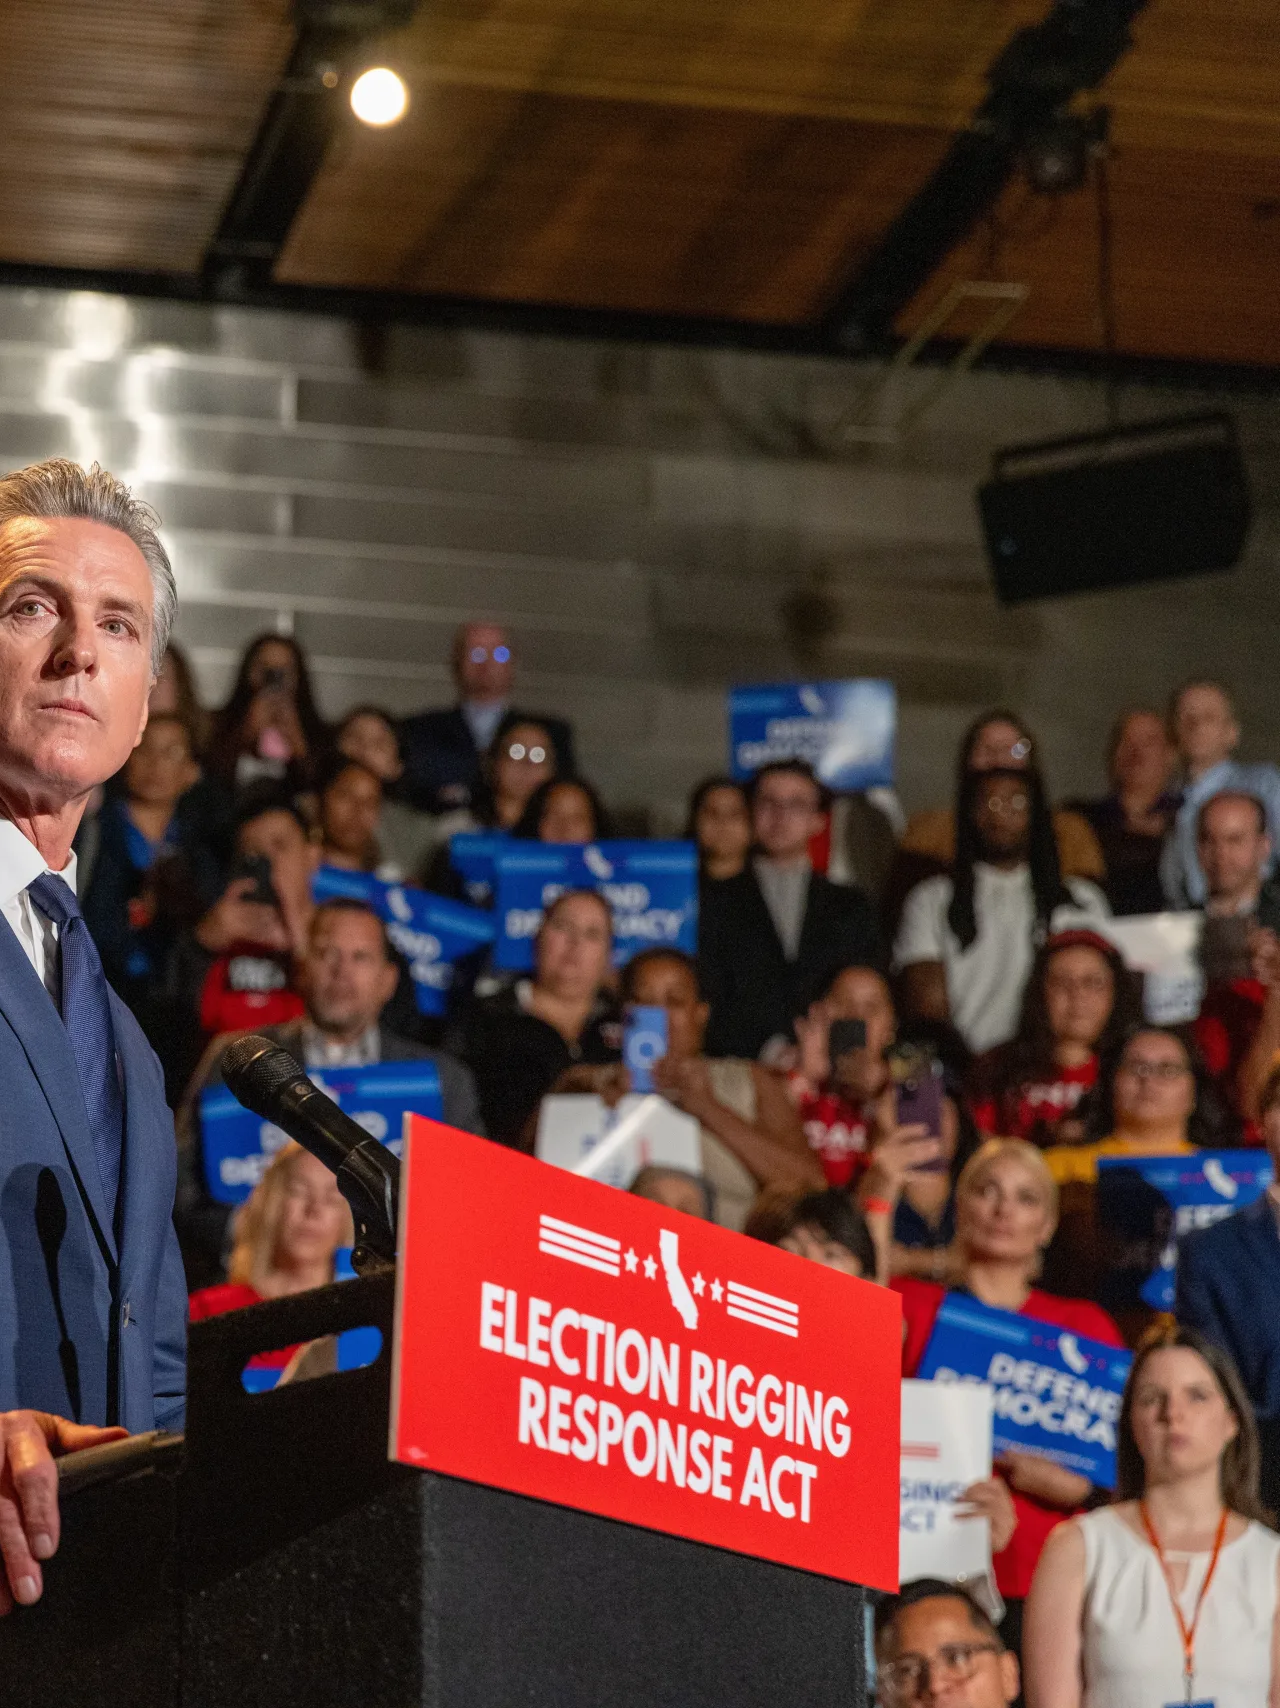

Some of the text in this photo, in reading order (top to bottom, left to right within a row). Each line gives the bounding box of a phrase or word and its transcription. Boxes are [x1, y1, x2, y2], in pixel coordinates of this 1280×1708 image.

[479, 1280, 852, 1458] ELECTION RIGGING
[987, 1352, 1123, 1425] DEFEND
[518, 1376, 818, 1524] RESPONSE ACT
